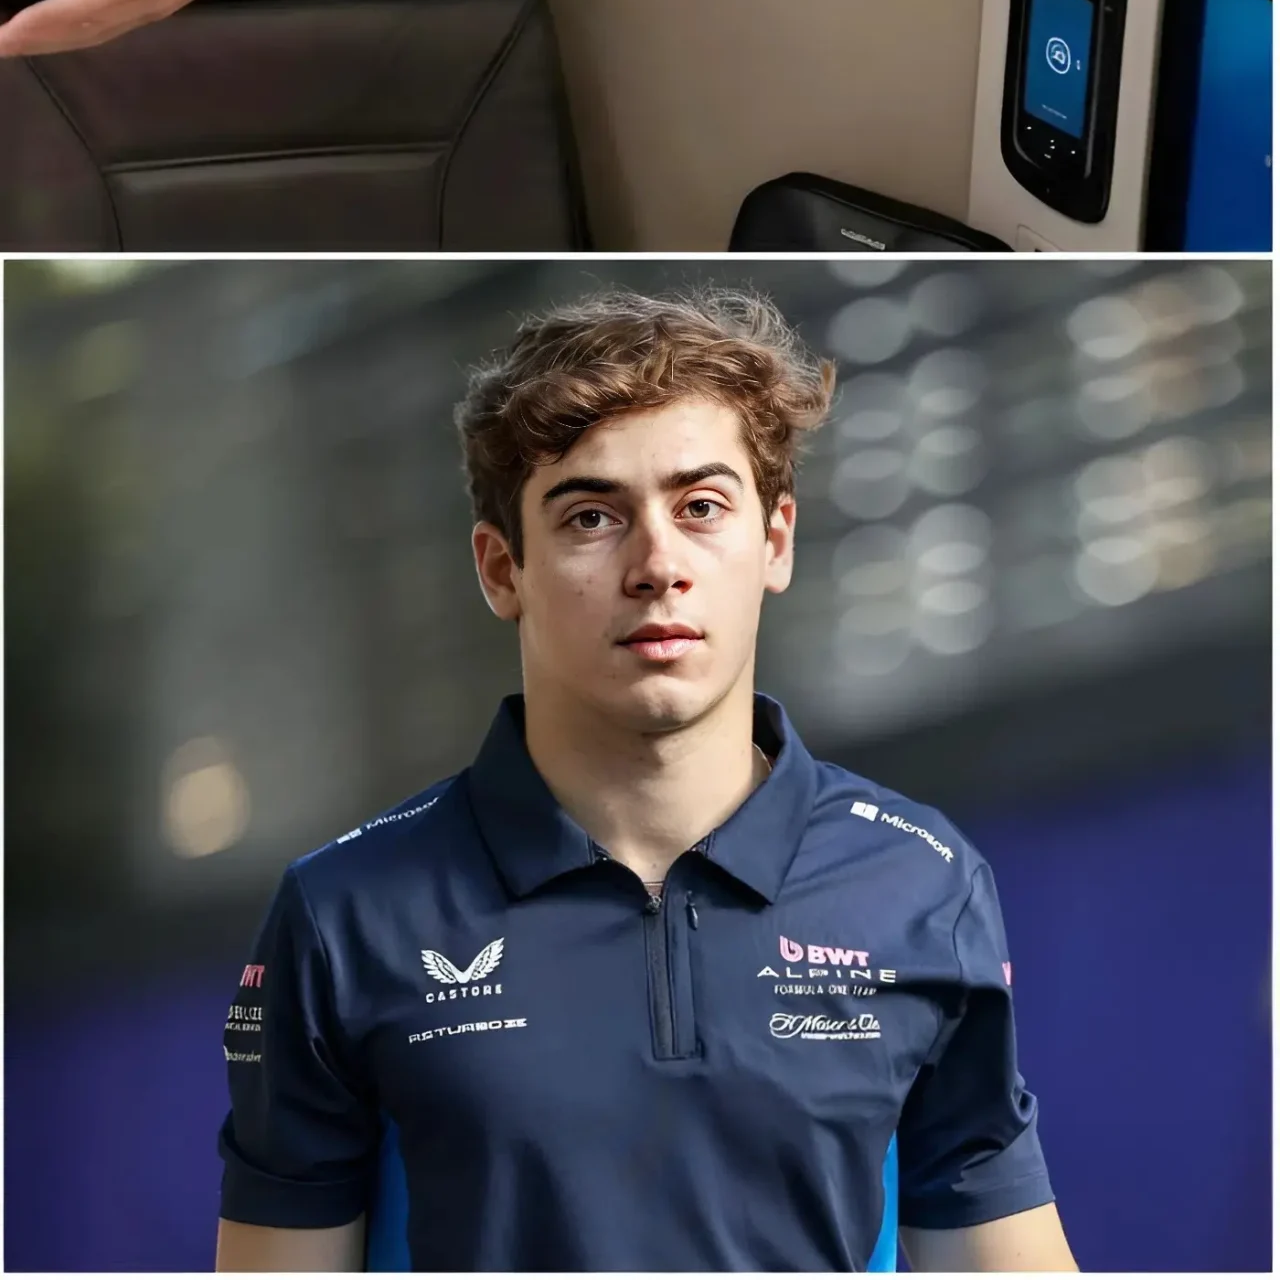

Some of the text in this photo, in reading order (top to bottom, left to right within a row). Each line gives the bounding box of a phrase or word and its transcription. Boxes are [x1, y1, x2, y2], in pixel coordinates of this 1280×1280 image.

[880, 812, 954, 863] Microsoft
[808, 944, 870, 967] BWT
[426, 984, 503, 1004] CASTORE
